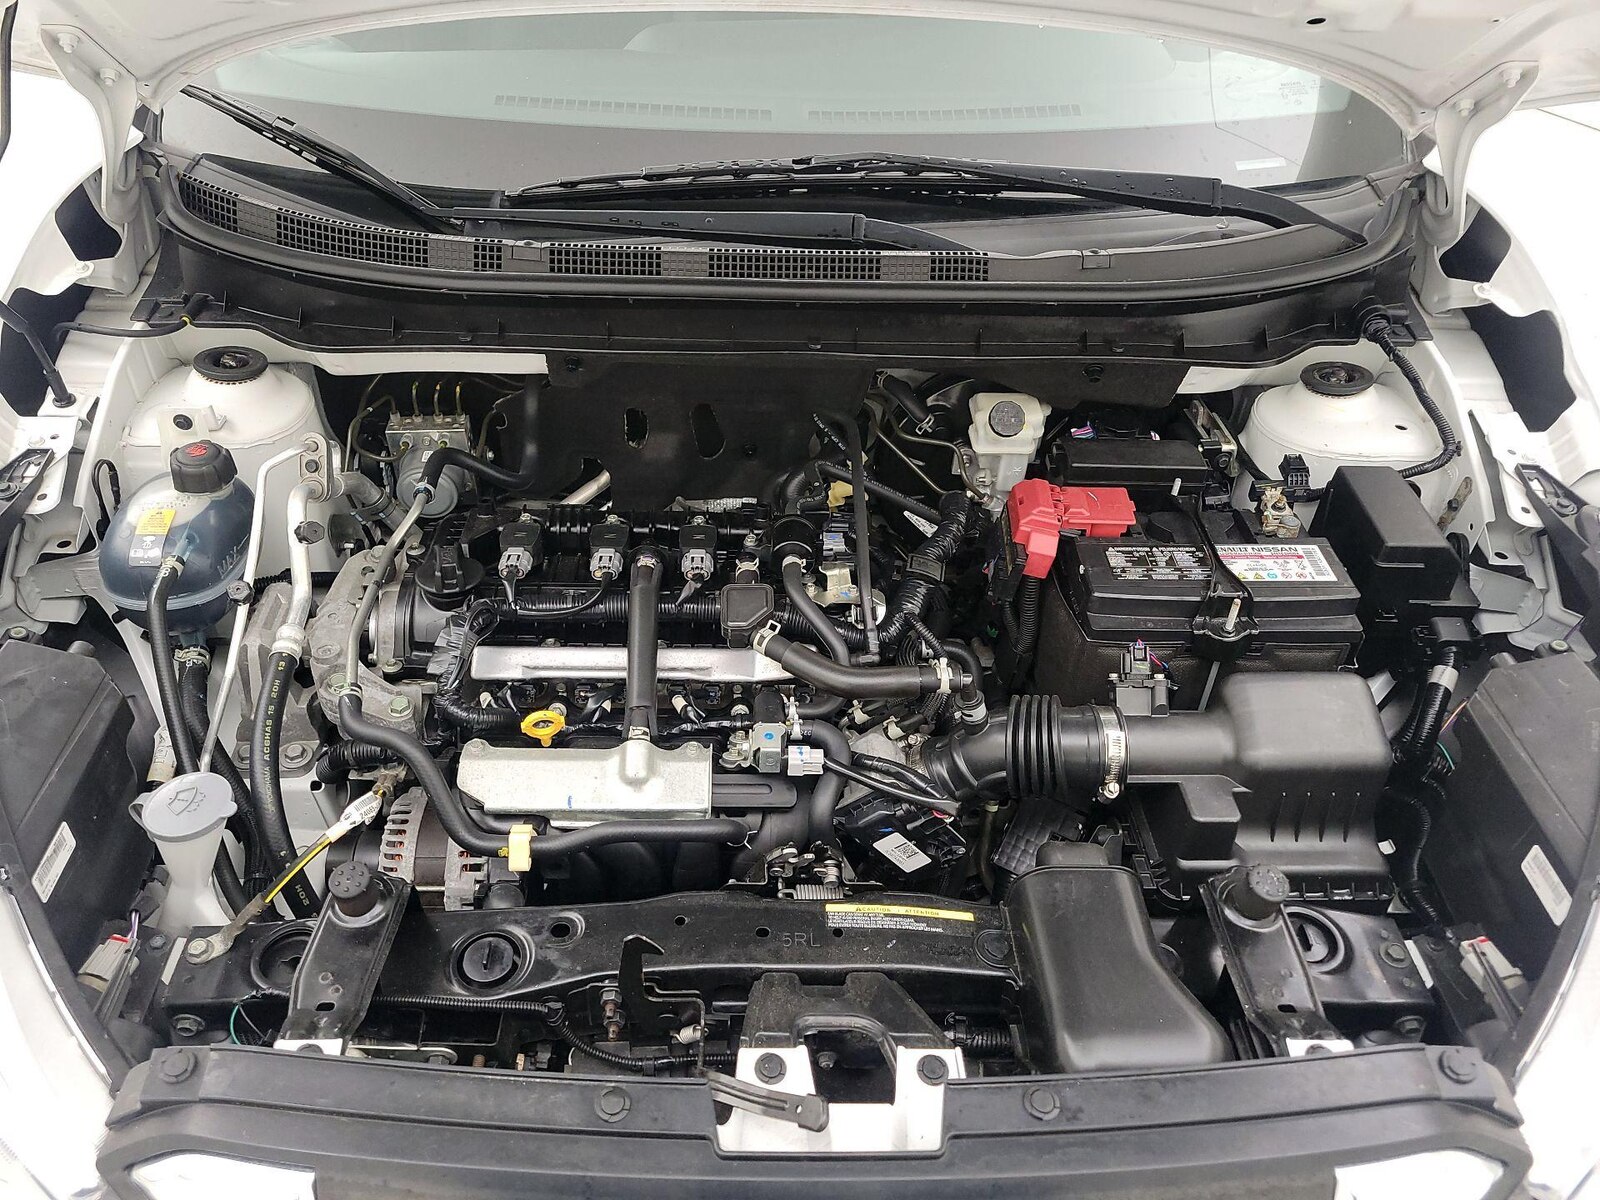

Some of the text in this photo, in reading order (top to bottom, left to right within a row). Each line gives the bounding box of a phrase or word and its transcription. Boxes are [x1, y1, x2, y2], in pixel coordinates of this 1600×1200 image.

[267, 704, 275, 716] 15
[904, 908, 940, 916] ATTENTION
[782, 932, 821, 947] 5RL
